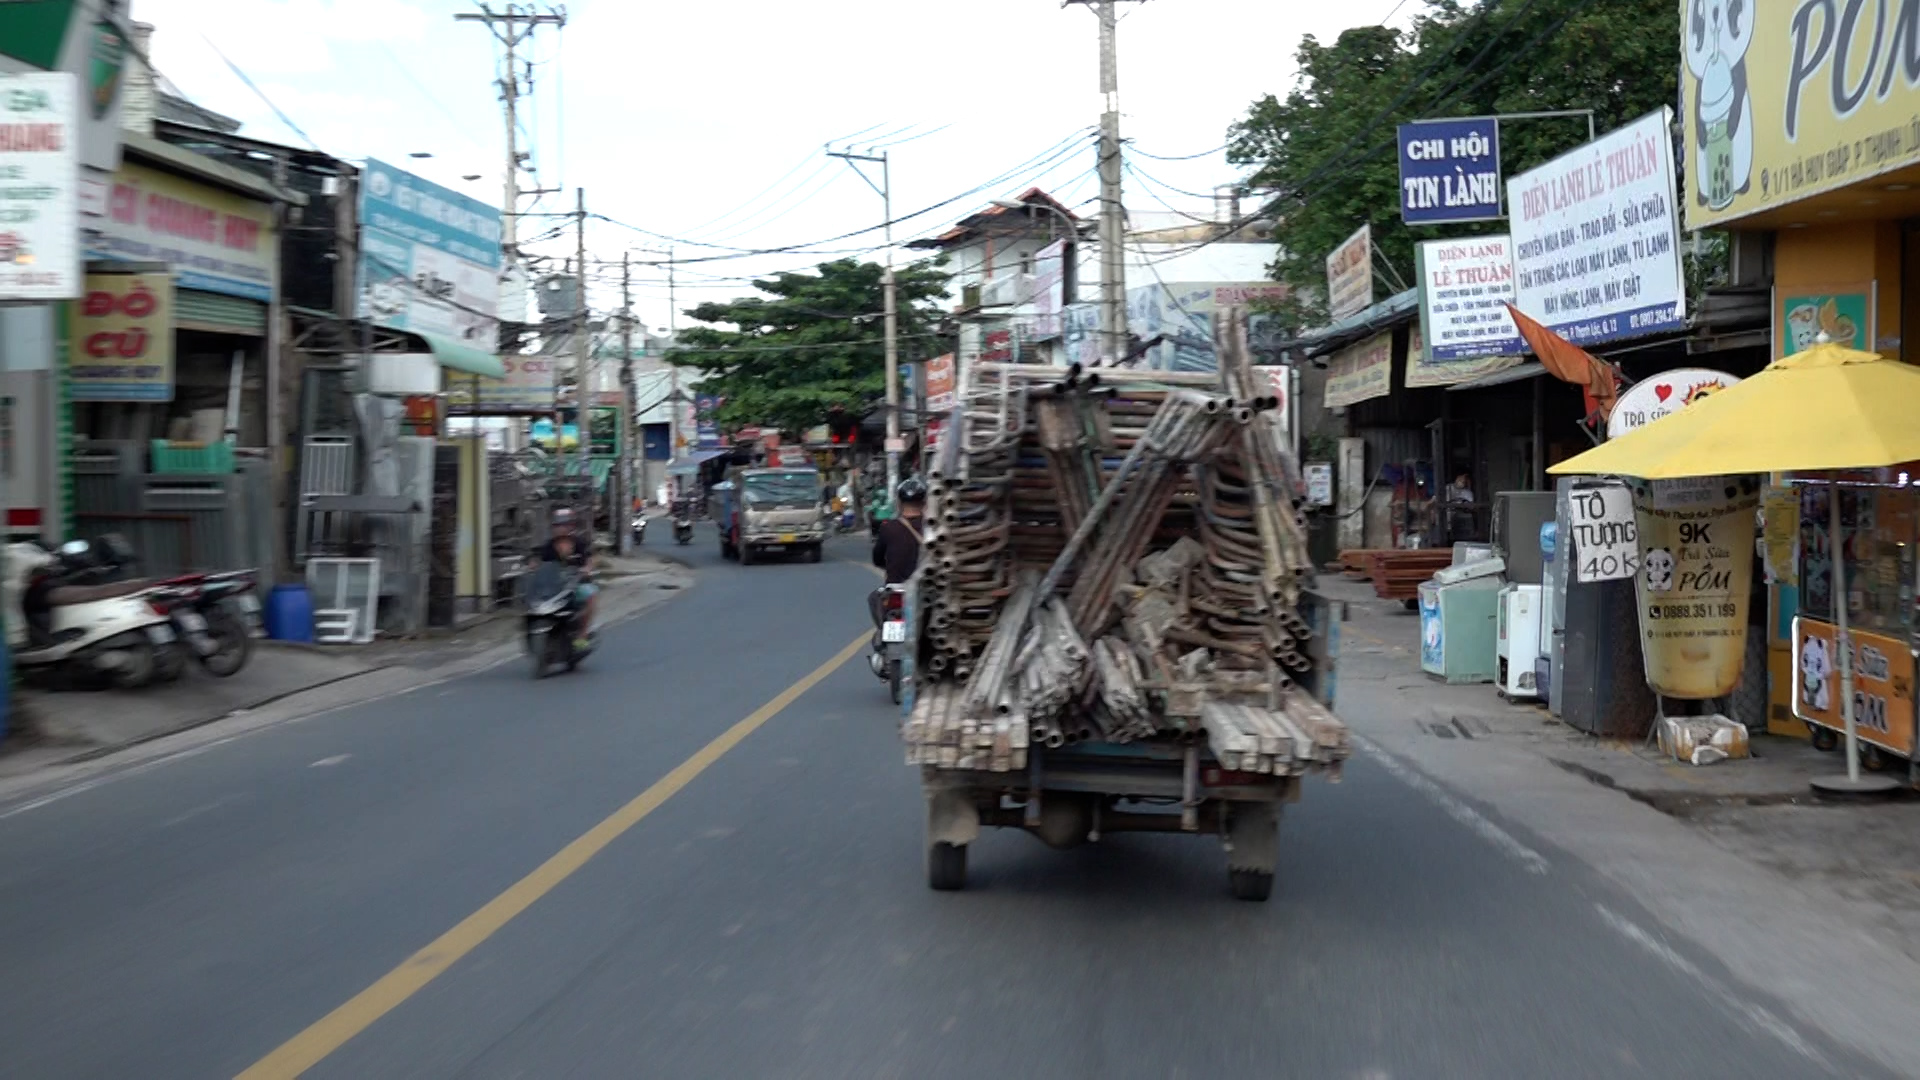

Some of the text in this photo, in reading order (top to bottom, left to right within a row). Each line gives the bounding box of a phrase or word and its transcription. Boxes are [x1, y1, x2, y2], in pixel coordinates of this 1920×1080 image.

[1407, 131, 1489, 162] CHI HỘI
[1404, 165, 1497, 208] TIN LÀNH
[1522, 176, 1549, 227] ĐIỆN
[1552, 167, 1586, 217] LẠNH
[1587, 150, 1604, 198] LÊ
[1580, 219, 1601, 241] TRAO
[1433, 265, 1452, 287] LÊ
[1679, 522, 1712, 544] 9K
[1678, 563, 1732, 592] PÔM
